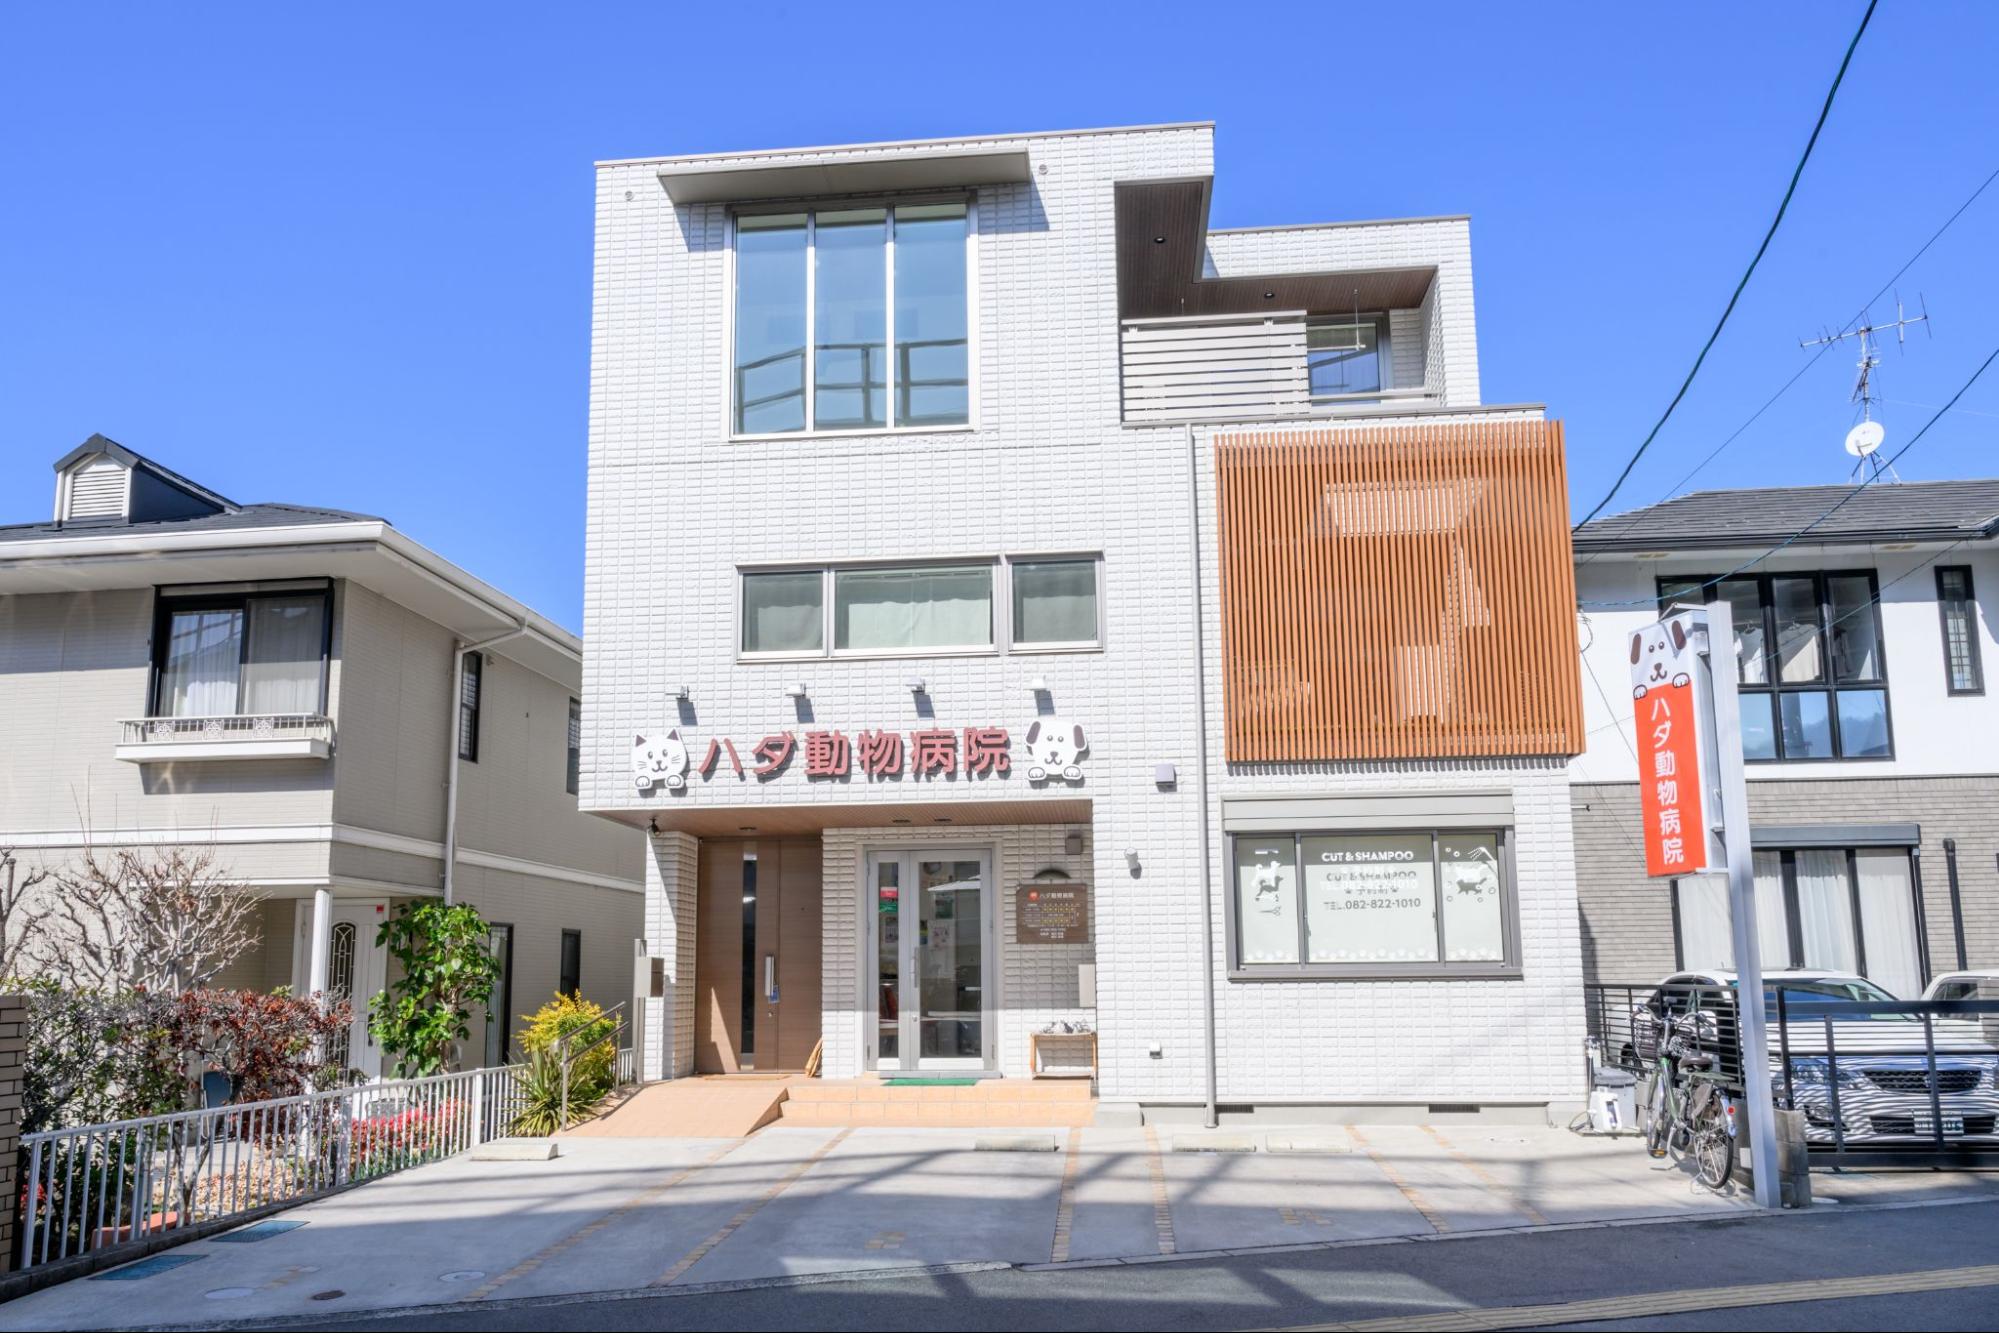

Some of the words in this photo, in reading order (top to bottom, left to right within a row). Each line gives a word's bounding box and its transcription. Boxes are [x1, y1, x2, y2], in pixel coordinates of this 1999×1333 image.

[699, 726, 1010, 777] ハダ動物病院
[1651, 697, 1684, 864] ハダ動物病院
[1321, 852, 1344, 862] CUT
[1345, 852, 1354, 861] &
[1355, 851, 1414, 861] SHAMPOO
